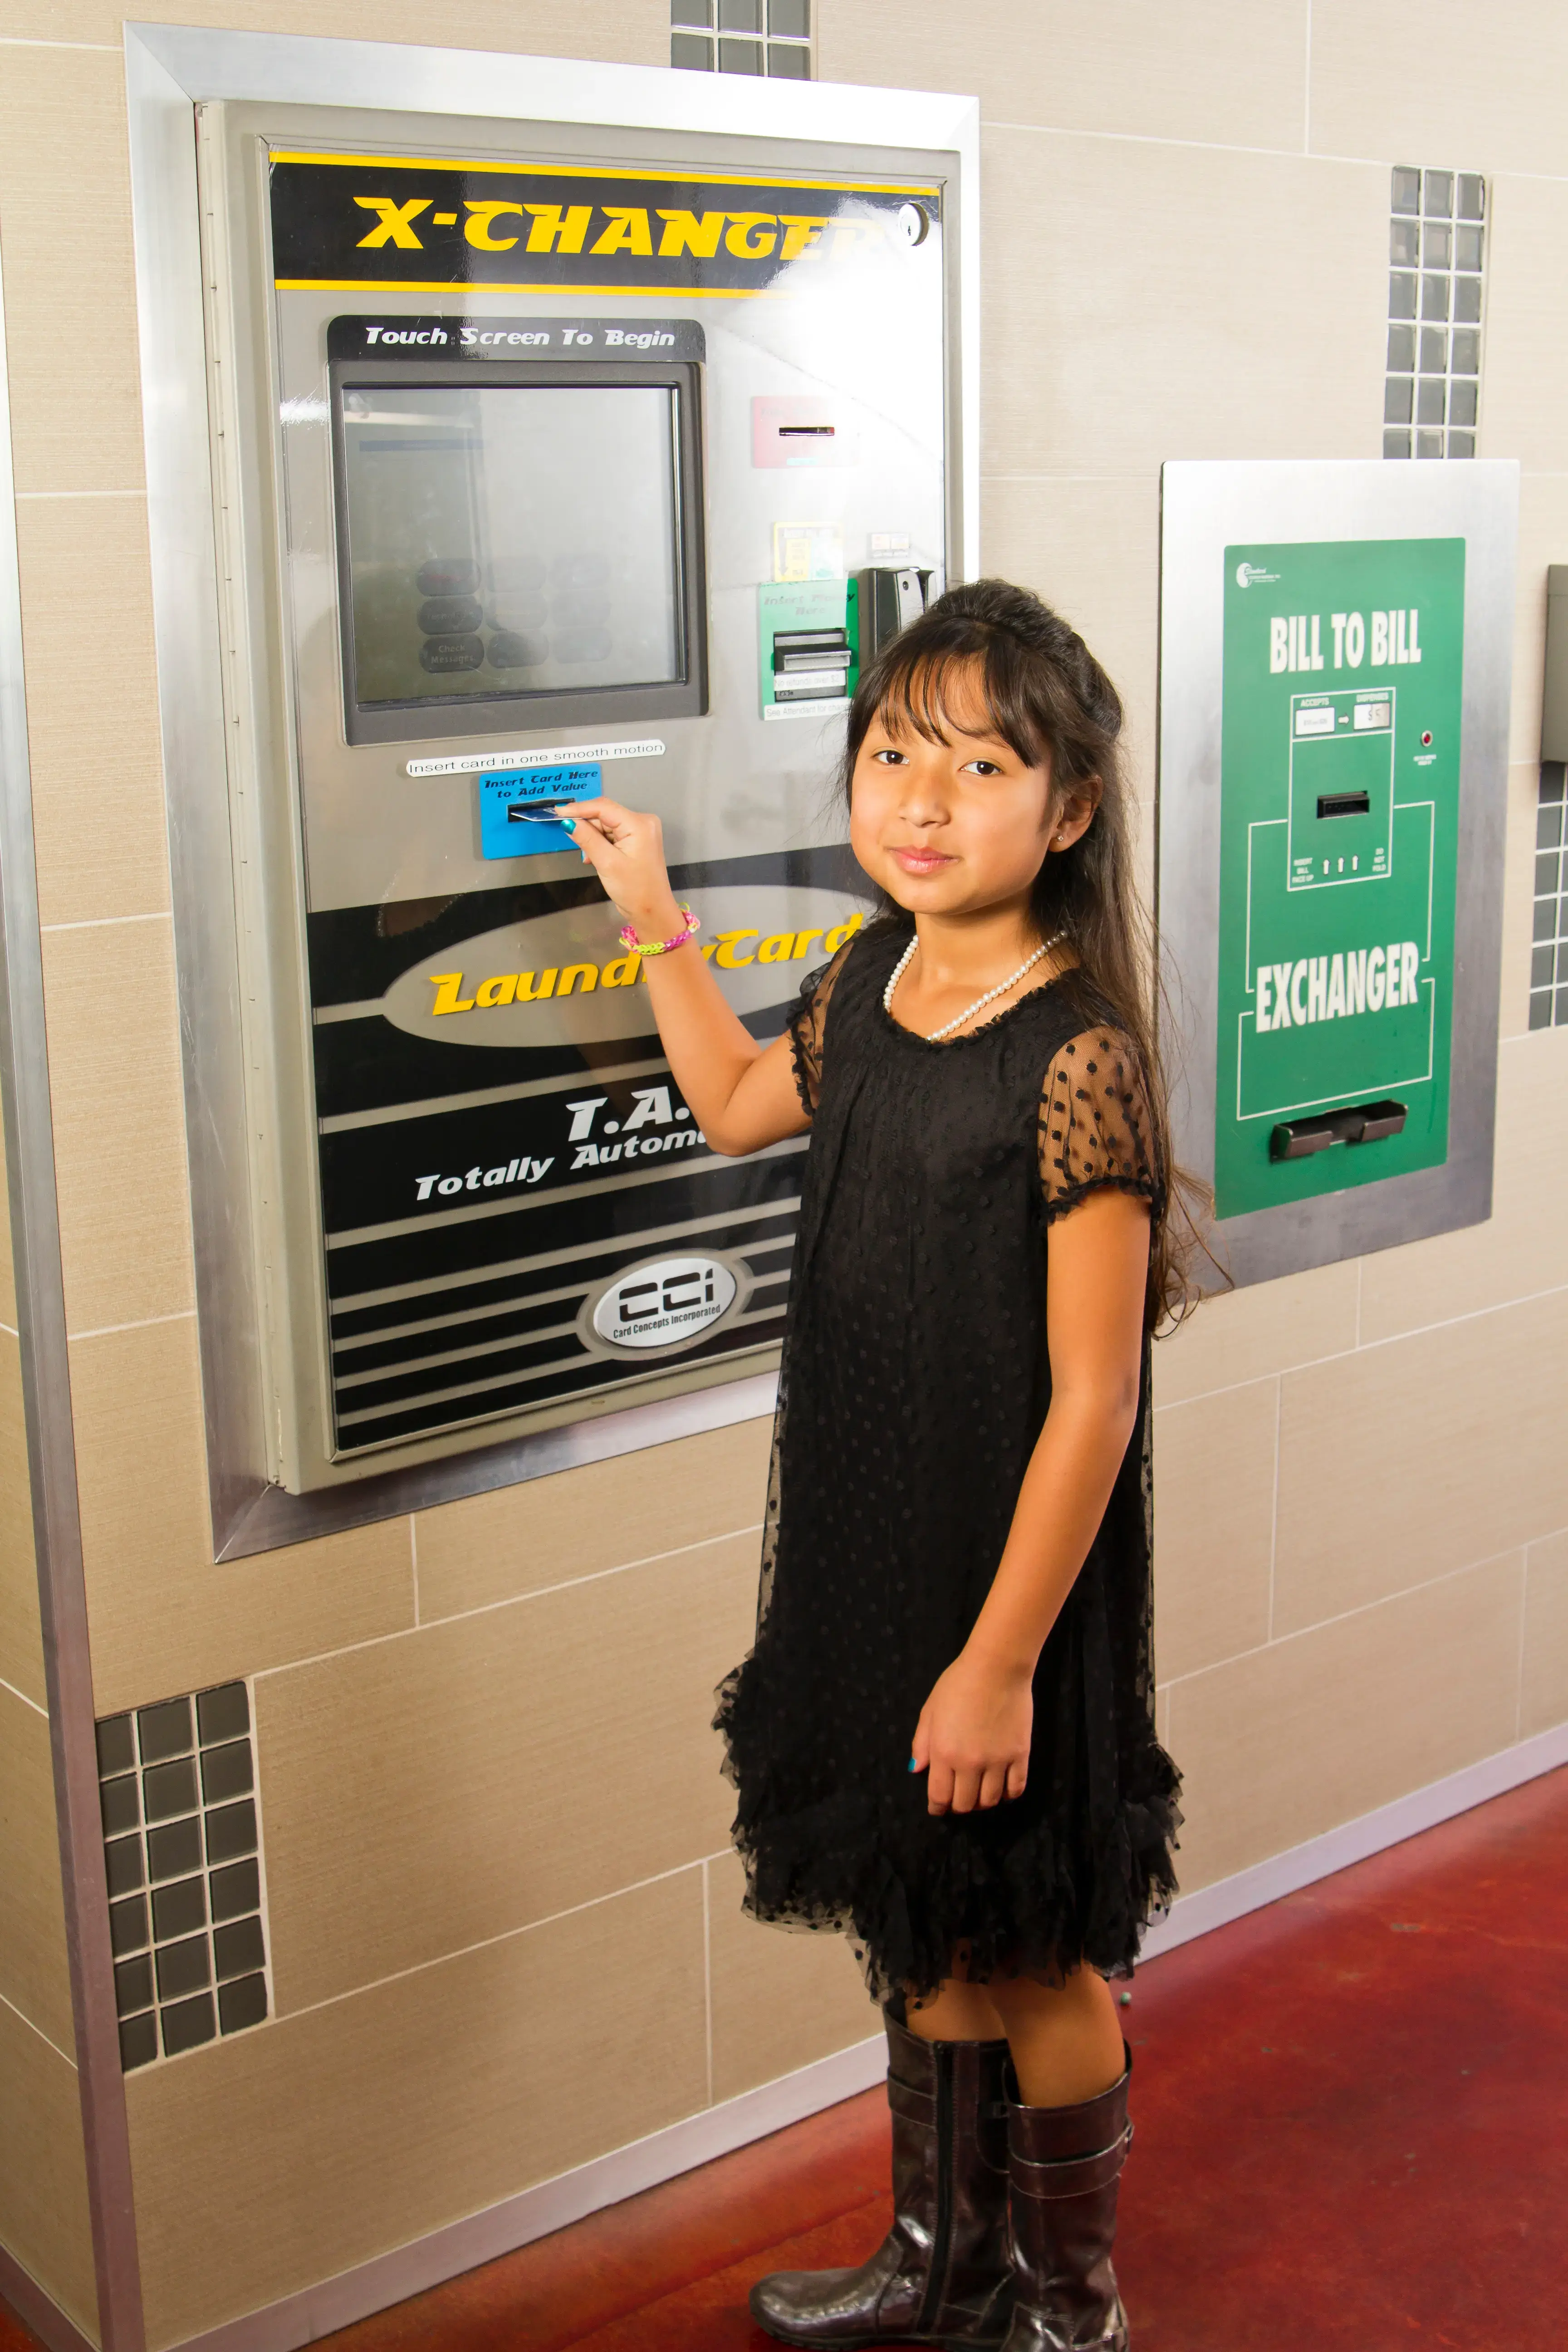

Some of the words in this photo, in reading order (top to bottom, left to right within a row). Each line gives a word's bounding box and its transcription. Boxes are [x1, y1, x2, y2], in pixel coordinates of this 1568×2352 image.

[353, 196, 887, 260] X-CHANGER
[365, 327, 447, 346] Touch
[460, 327, 550, 346] Screen
[561, 329, 591, 346] To
[603, 329, 675, 348] Begin
[764, 595, 804, 606] Insert
[811, 593, 855, 603] Moy
[438, 645, 466, 653] Check
[1269, 614, 1324, 673] BILL
[1331, 611, 1365, 669] TO
[1370, 609, 1422, 666] BILL
[431, 655, 474, 665] Messages
[813, 676, 829, 684] over
[766, 709, 780, 717] See
[783, 706, 816, 715] Attendant
[409, 761, 456, 774] Insert
[461, 758, 495, 770] card
[501, 756, 515, 765] in
[520, 755, 548, 764] one
[554, 748, 609, 761] smooth
[614, 743, 663, 756] motion
[484, 776, 525, 789] Insert
[531, 772, 562, 784] Card
[569, 769, 598, 780] Here
[497, 788, 511, 798] to
[518, 785, 545, 796] Add
[551, 781, 588, 793] Value
[428, 913, 864, 1016] LaundCard
[1256, 941, 1419, 1034] EXCHANGER
[415, 1156, 554, 1201] Totally
[613, 1326, 631, 1339] Card
[633, 1318, 670, 1334] Concepts
[671, 1304, 721, 1325] Incorporated
